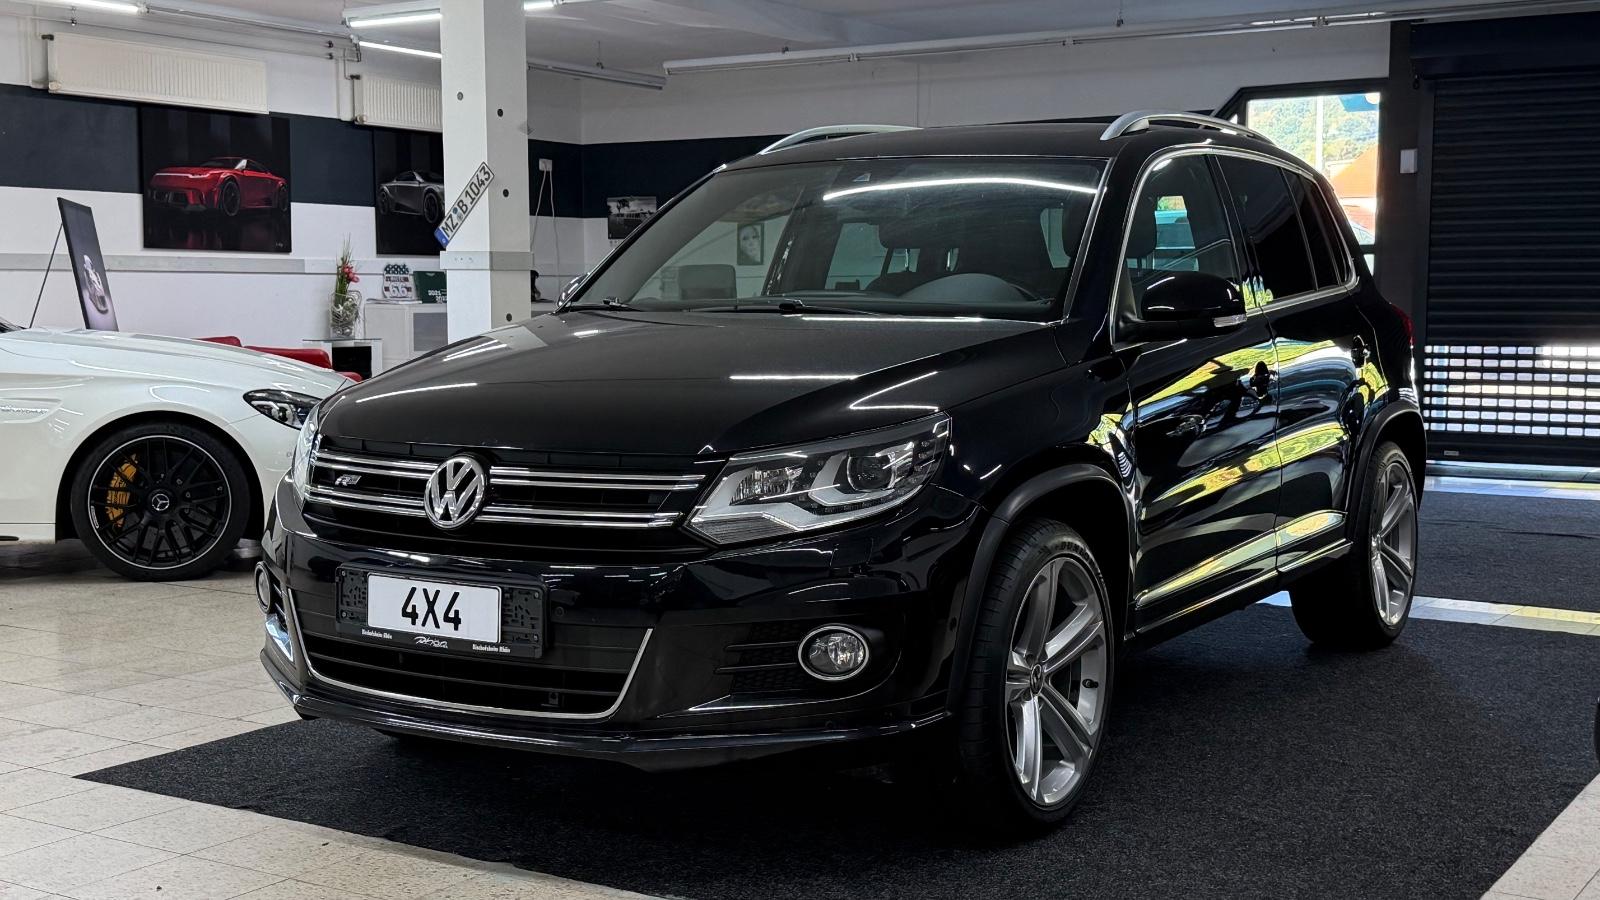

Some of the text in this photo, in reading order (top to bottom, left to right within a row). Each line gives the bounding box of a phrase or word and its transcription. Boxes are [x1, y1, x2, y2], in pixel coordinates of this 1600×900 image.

[441, 165, 491, 238] MZ B 1043
[389, 282, 408, 297] 66
[401, 586, 462, 631] 4X4
